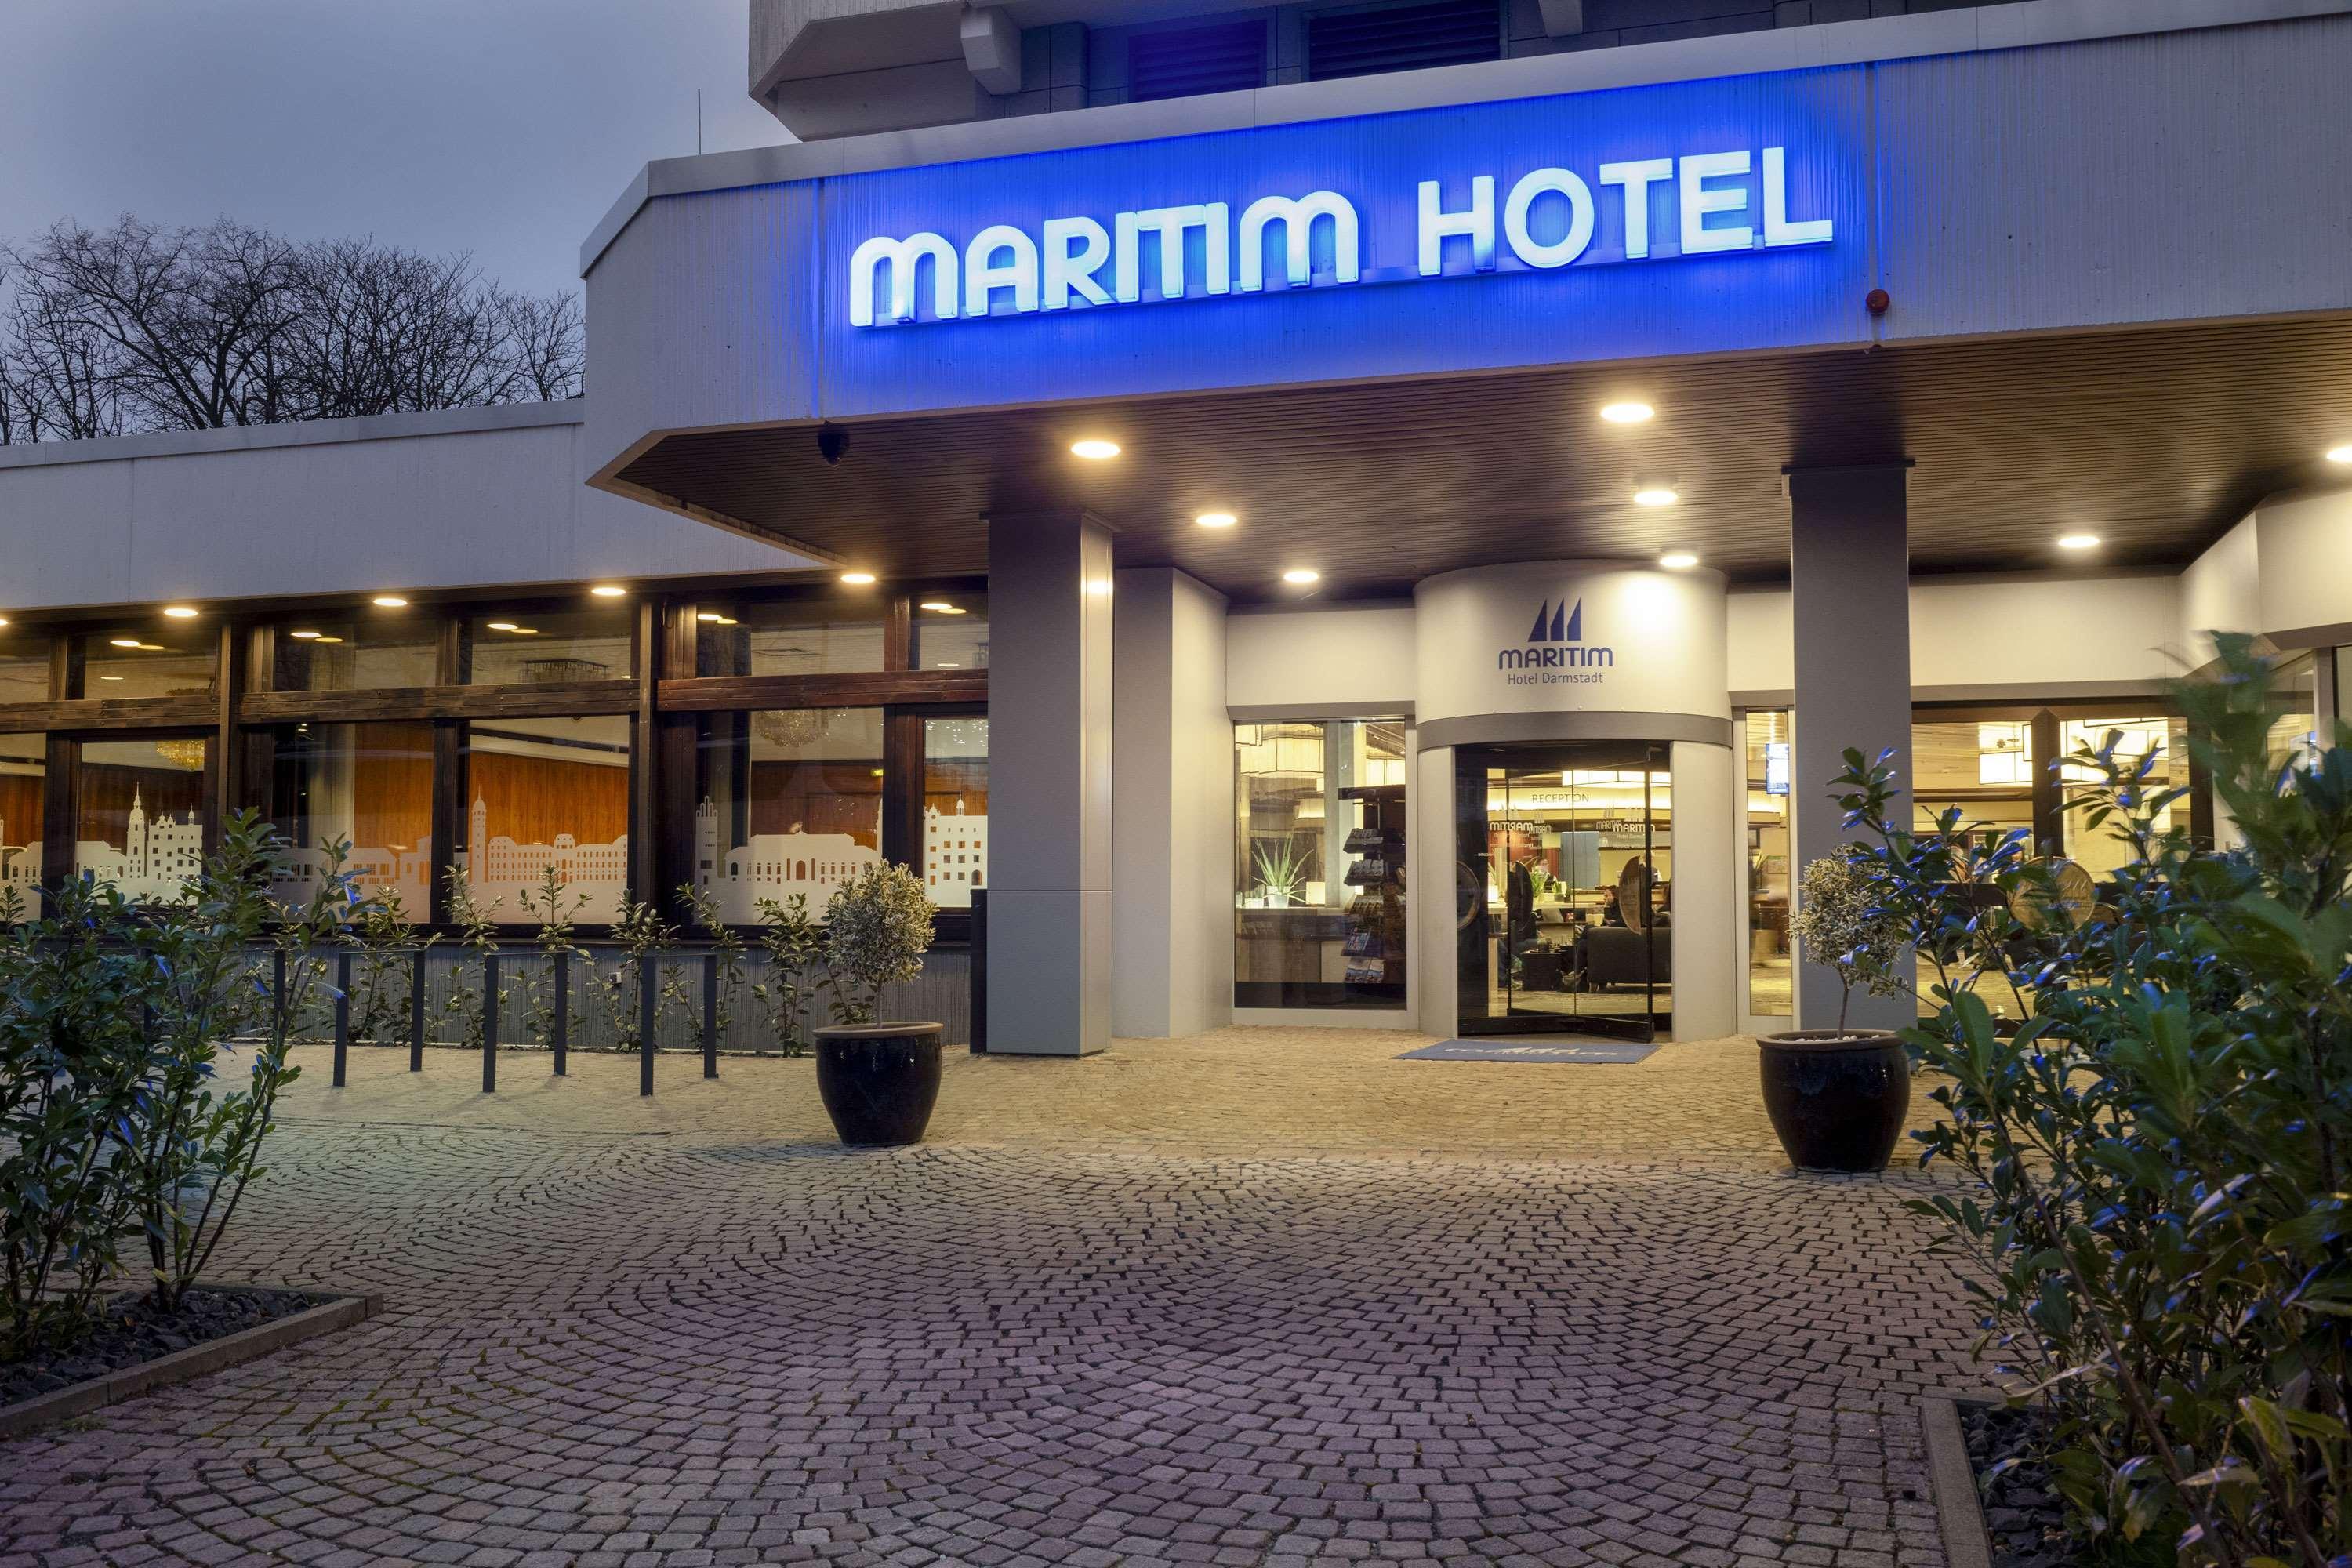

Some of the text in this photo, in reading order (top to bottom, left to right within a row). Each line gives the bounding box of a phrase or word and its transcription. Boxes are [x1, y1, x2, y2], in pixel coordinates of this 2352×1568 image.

[851, 147, 1833, 327] MARITIM HOTEL
[1498, 647, 1613, 669] MARITIM
[1508, 672, 1604, 684] Hotel Darmstadt
[1531, 793, 1590, 804] RECEPTON
